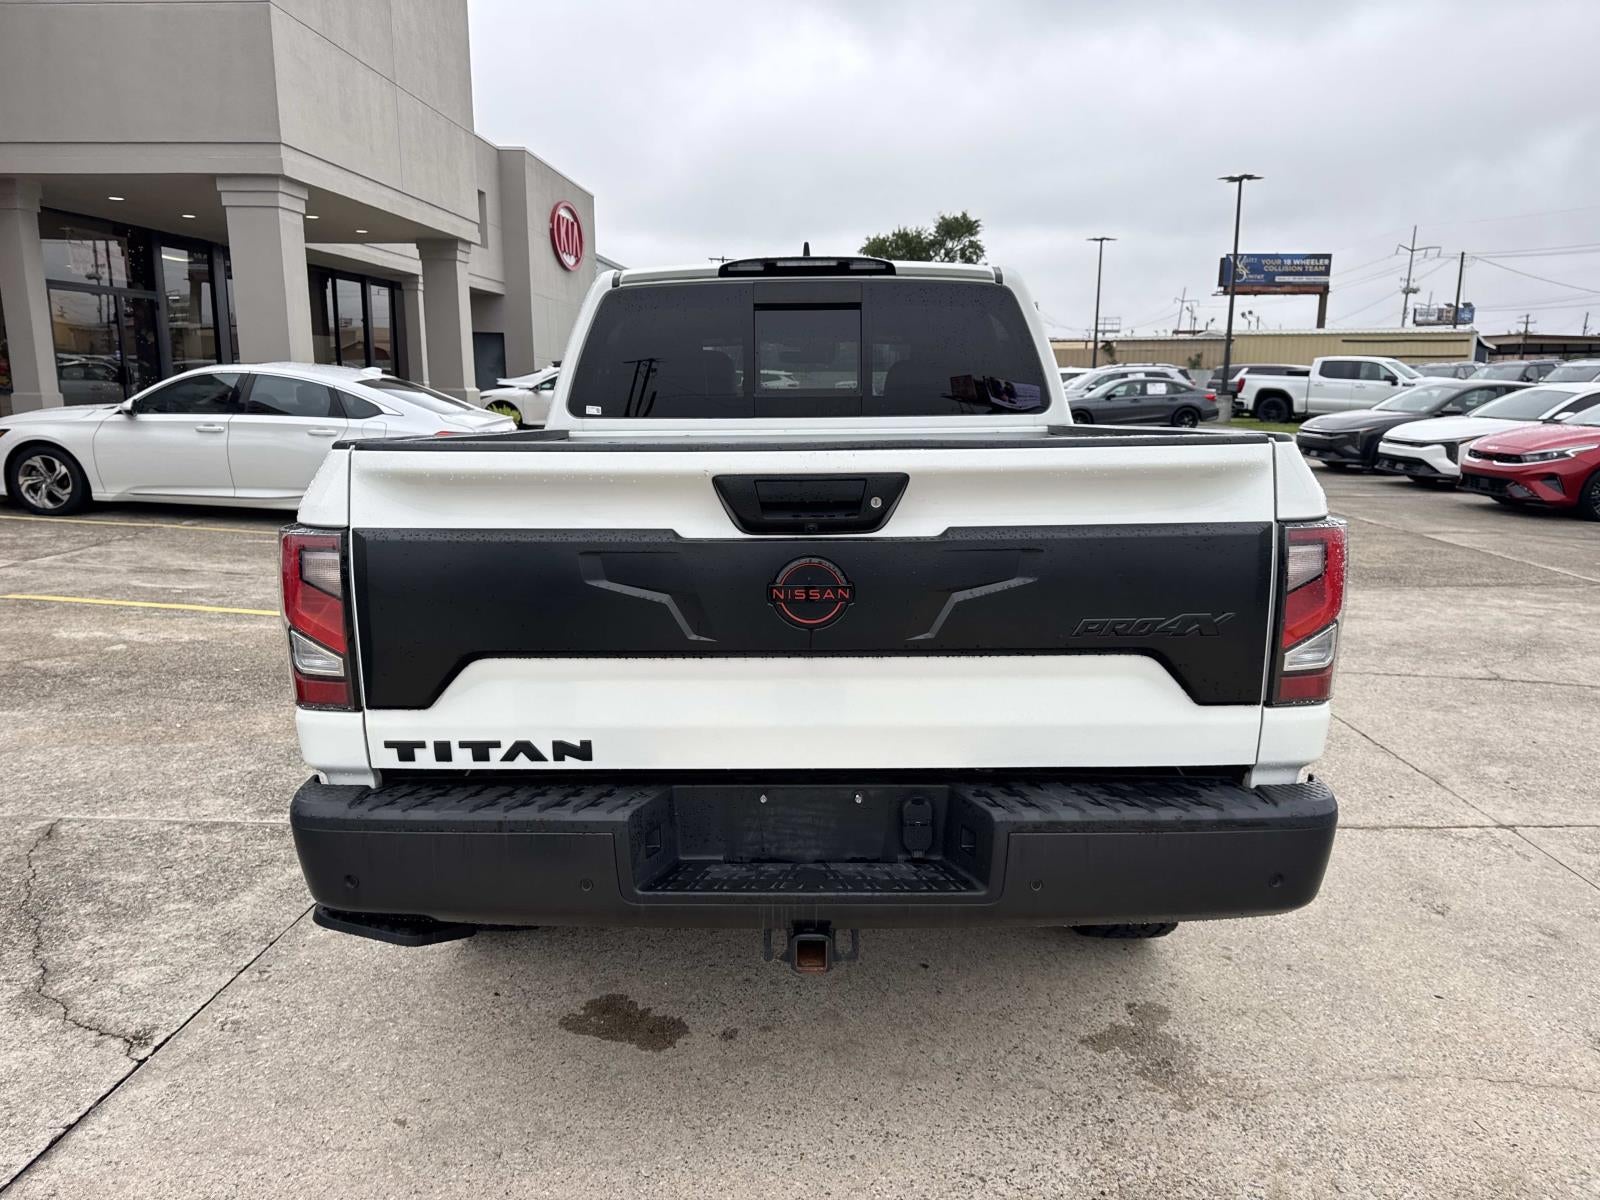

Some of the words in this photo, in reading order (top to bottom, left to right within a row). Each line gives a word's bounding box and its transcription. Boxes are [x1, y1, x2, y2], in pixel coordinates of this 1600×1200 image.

[559, 213, 581, 259] KIA
[1261, 258, 1281, 266] YOUR
[1283, 258, 1292, 266] 18
[1293, 258, 1330, 266] WHEELER
[772, 588, 850, 601] NISSAN
[383, 739, 593, 762] TITAN
